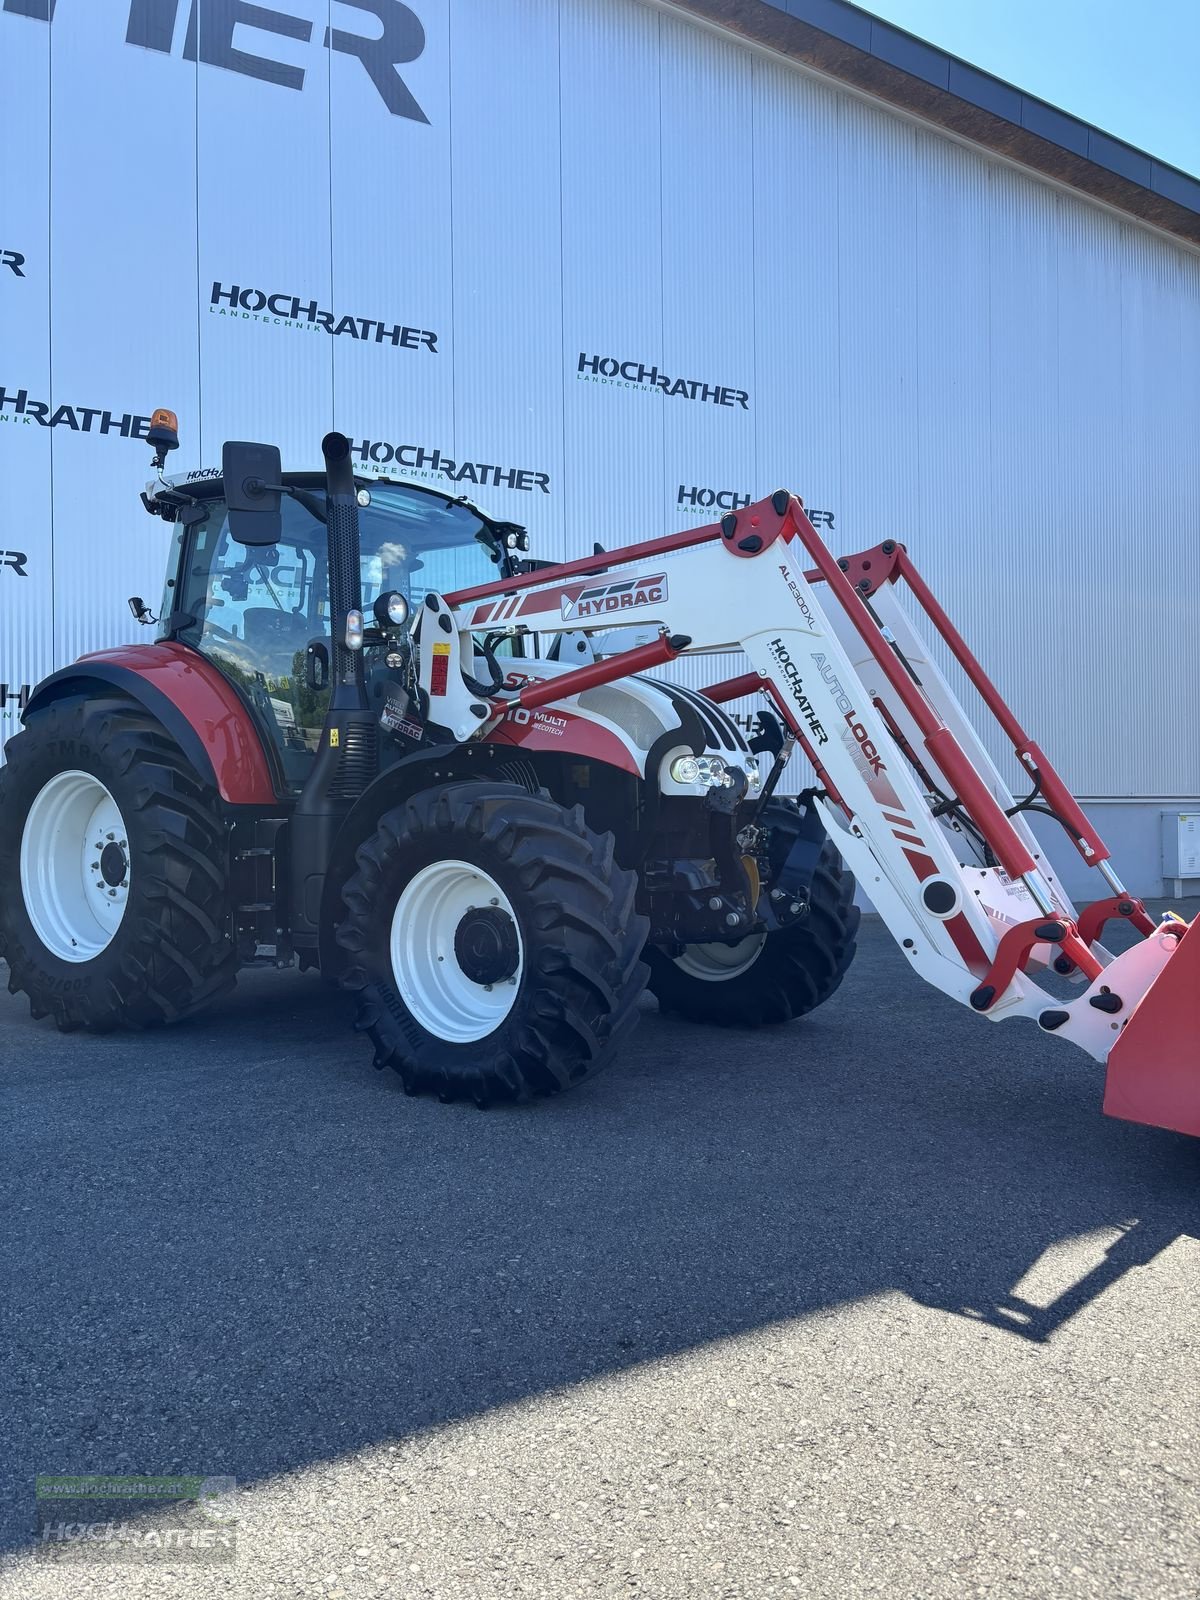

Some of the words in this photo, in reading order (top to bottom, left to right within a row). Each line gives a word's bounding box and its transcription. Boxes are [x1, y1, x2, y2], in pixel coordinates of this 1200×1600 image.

[209, 306, 321, 333] LANDTECHNIK
[210, 281, 439, 354] HOCHRATHER
[576, 374, 660, 394] LANDTECHNIK
[577, 352, 749, 410] HOCHRATHER
[346, 438, 550, 494] HOCHRATHER
[352, 463, 444, 480] ANDTECHNIK
[578, 587, 662, 616] HYDRAC
[779, 564, 789, 582] AL
[787, 580, 816, 631] 2300XL
[770, 638, 829, 747] HOCHRATHER
[387, 718, 421, 739] HYDRAC
[533, 711, 568, 728] MULTI
